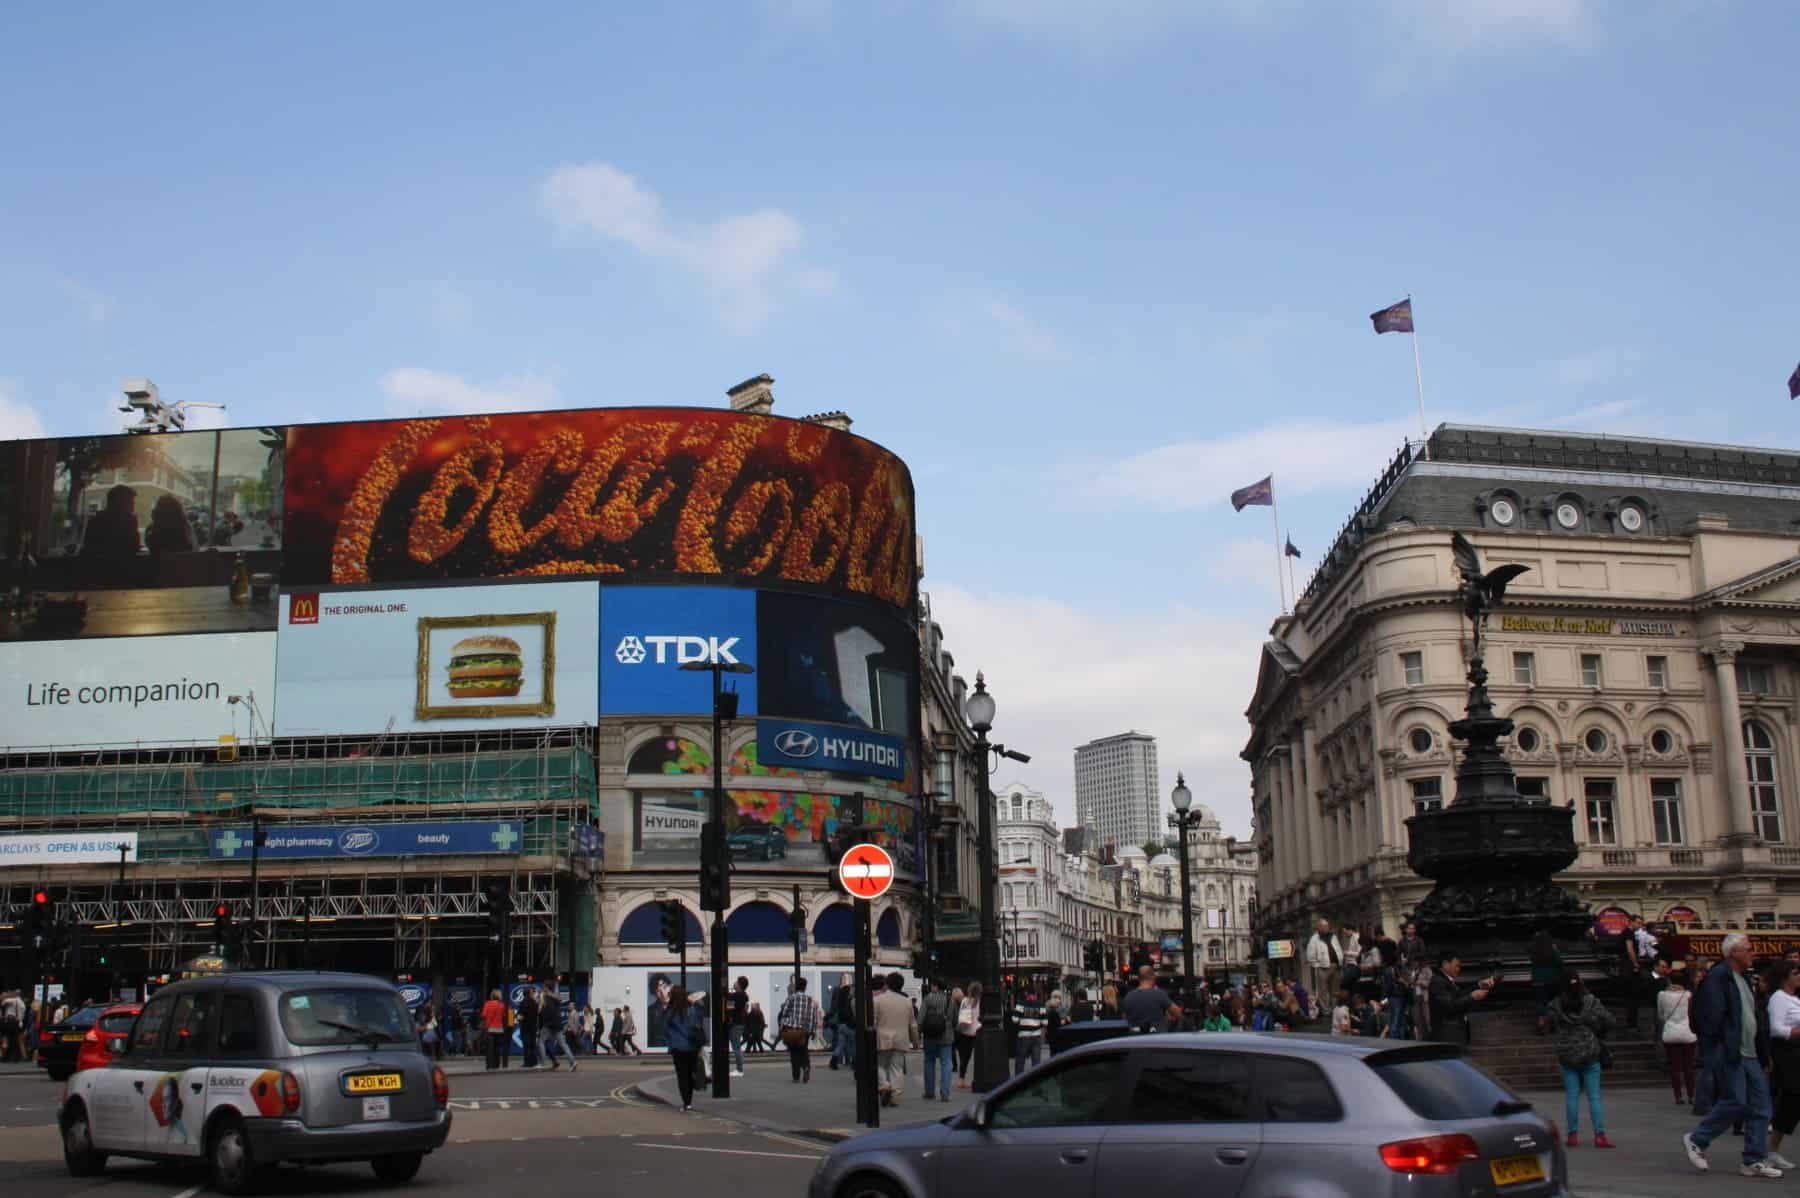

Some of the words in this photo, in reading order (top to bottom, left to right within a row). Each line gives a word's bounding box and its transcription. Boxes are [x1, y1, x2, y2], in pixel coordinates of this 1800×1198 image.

[324, 605, 341, 616] THE
[343, 604, 385, 615] ORIGINAL
[1502, 615, 1551, 632] Believe
[1567, 621, 1583, 633] or
[644, 635, 740, 664] TDK
[27, 682, 72, 706] Life
[77, 677, 221, 708] companion
[823, 736, 900, 769] HYUNDAI
[645, 815, 699, 829] HYUNDAI
[286, 835, 334, 850] pharmacy
[417, 832, 450, 845] beauty
[47, 841, 79, 853] OPEN
[80, 841, 96, 852] AS
